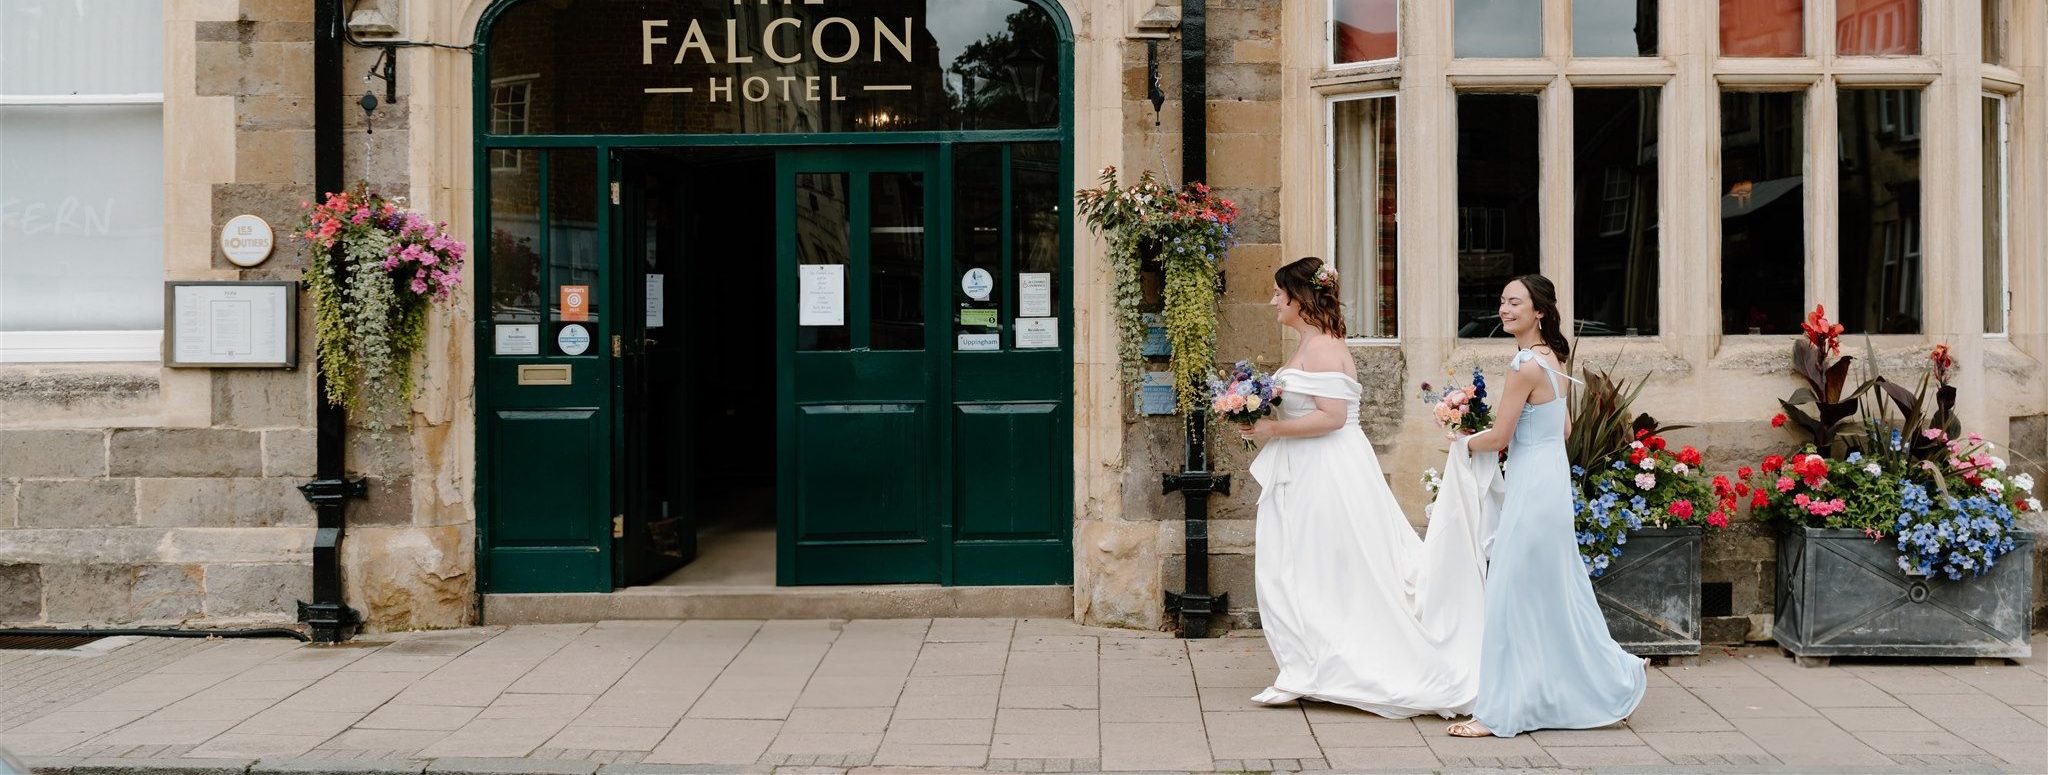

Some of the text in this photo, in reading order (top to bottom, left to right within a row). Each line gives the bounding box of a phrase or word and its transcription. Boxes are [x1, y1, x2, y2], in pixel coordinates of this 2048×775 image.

[642, 16, 912, 64] FALCON
[709, 75, 846, 102] HOTEL
[224, 237, 269, 249] ROUTIERS
[962, 338, 998, 347] Uppingham
